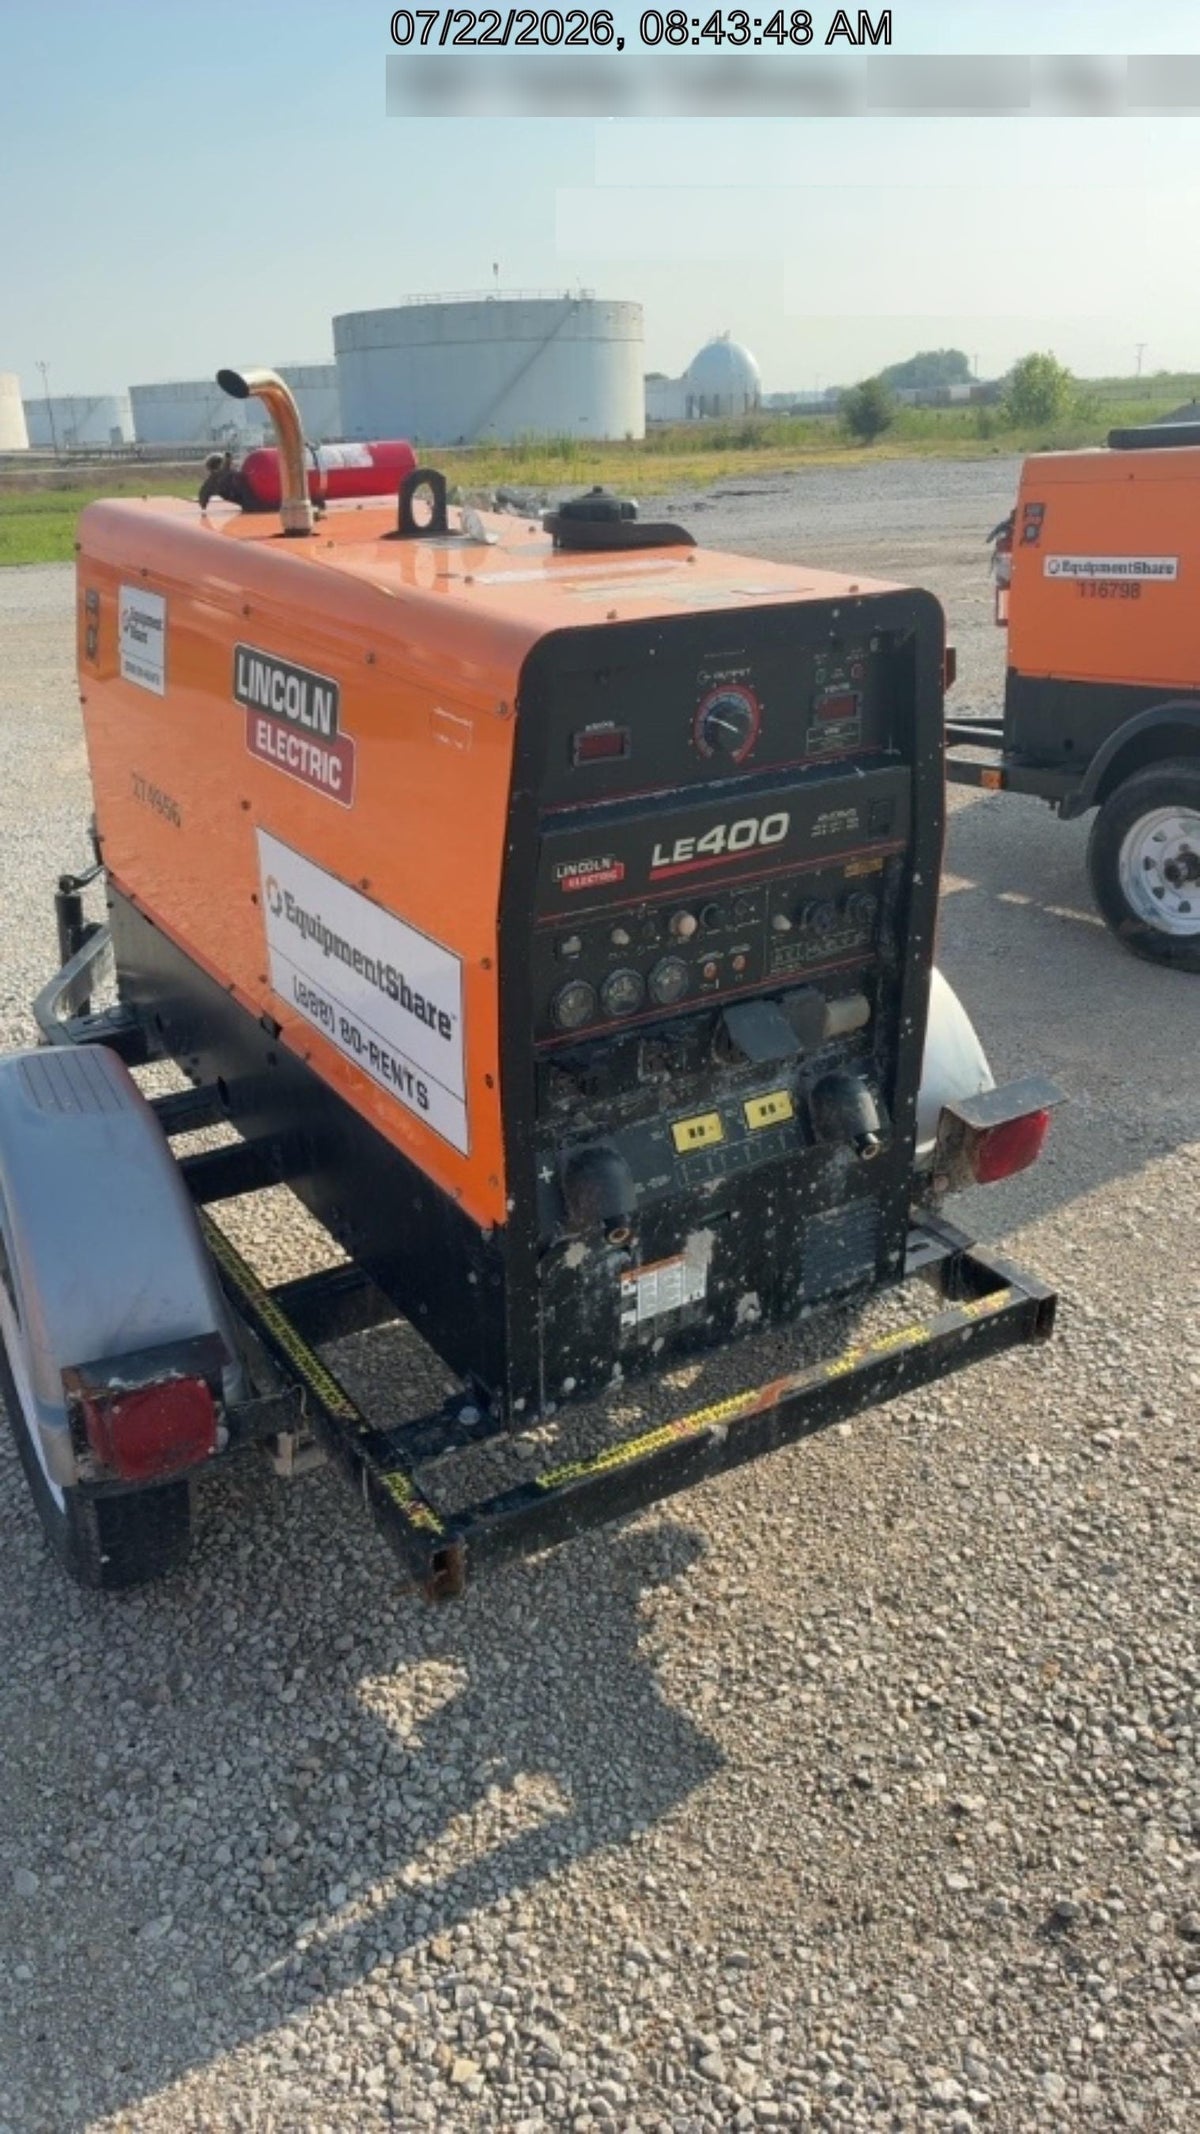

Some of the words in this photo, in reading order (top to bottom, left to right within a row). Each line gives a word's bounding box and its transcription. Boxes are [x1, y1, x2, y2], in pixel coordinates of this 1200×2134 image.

[1062, 560, 1175, 576] EquipmentShare
[1077, 581, 1142, 599] 116798
[237, 653, 333, 736] LINCOLN
[255, 719, 343, 791] ELECTRIC
[556, 857, 612, 878] LINCOLN
[651, 812, 790, 867] LE400
[283, 890, 453, 1042] EquipmentShare
[293, 974, 335, 1034] (888)
[338, 1016, 429, 1110] 80-RENTS
